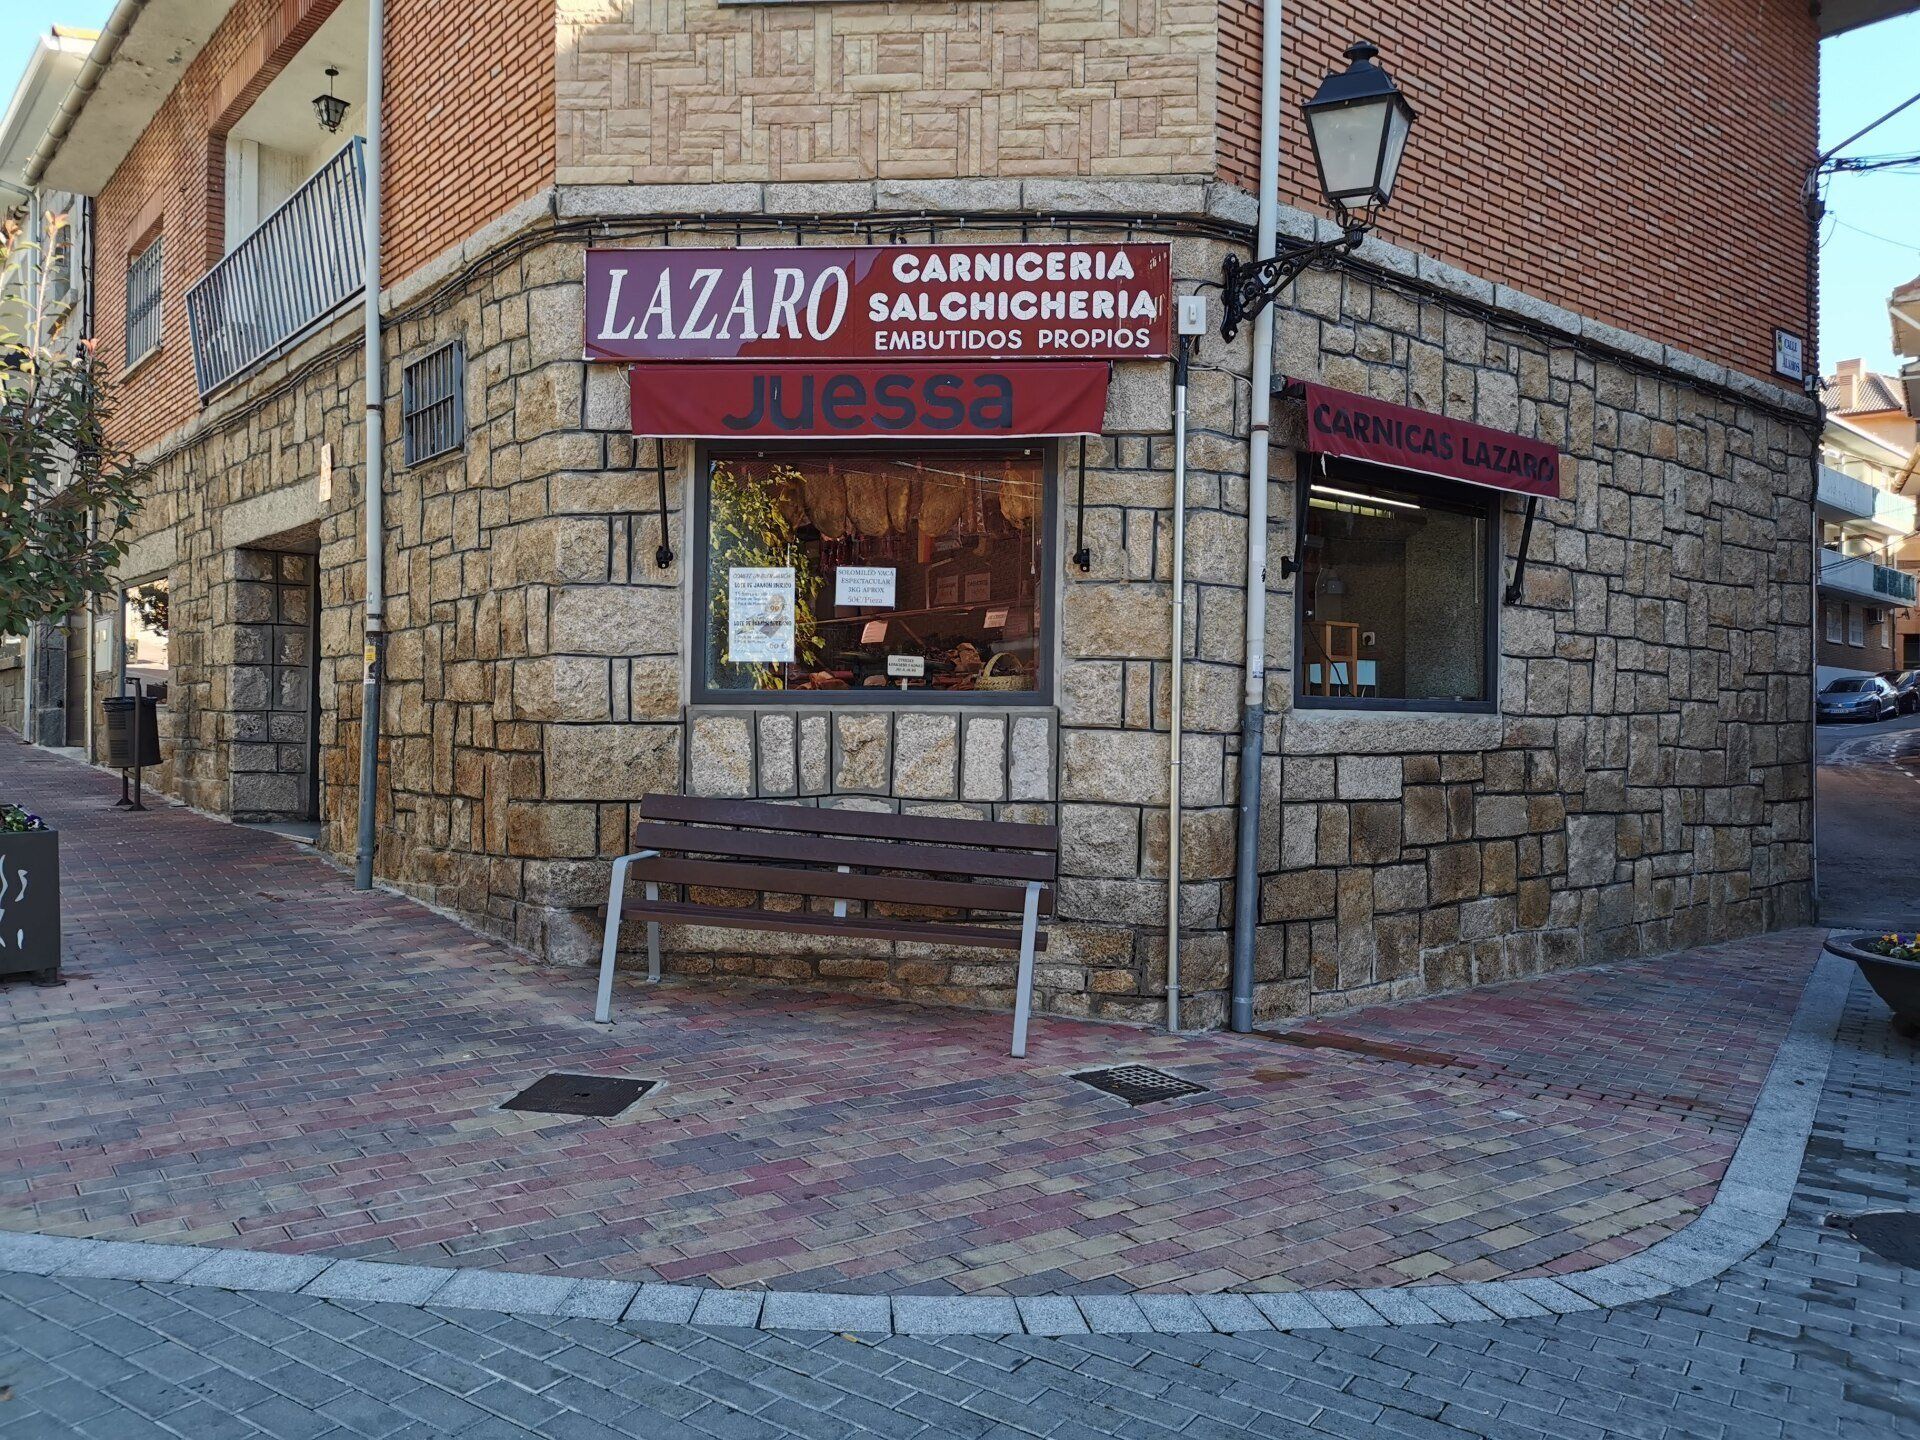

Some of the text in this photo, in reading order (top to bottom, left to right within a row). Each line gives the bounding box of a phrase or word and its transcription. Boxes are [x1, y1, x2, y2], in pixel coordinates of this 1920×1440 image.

[891, 251, 1135, 284] CARNICERIA
[597, 265, 851, 342] LAZARO
[868, 290, 1158, 324] SALCHICHERIA
[874, 328, 1151, 352] EMBUTIDOS PROPIOS
[1784, 338, 1798, 352] CALLE
[1313, 403, 1555, 482] CARNICAS LAZARO
